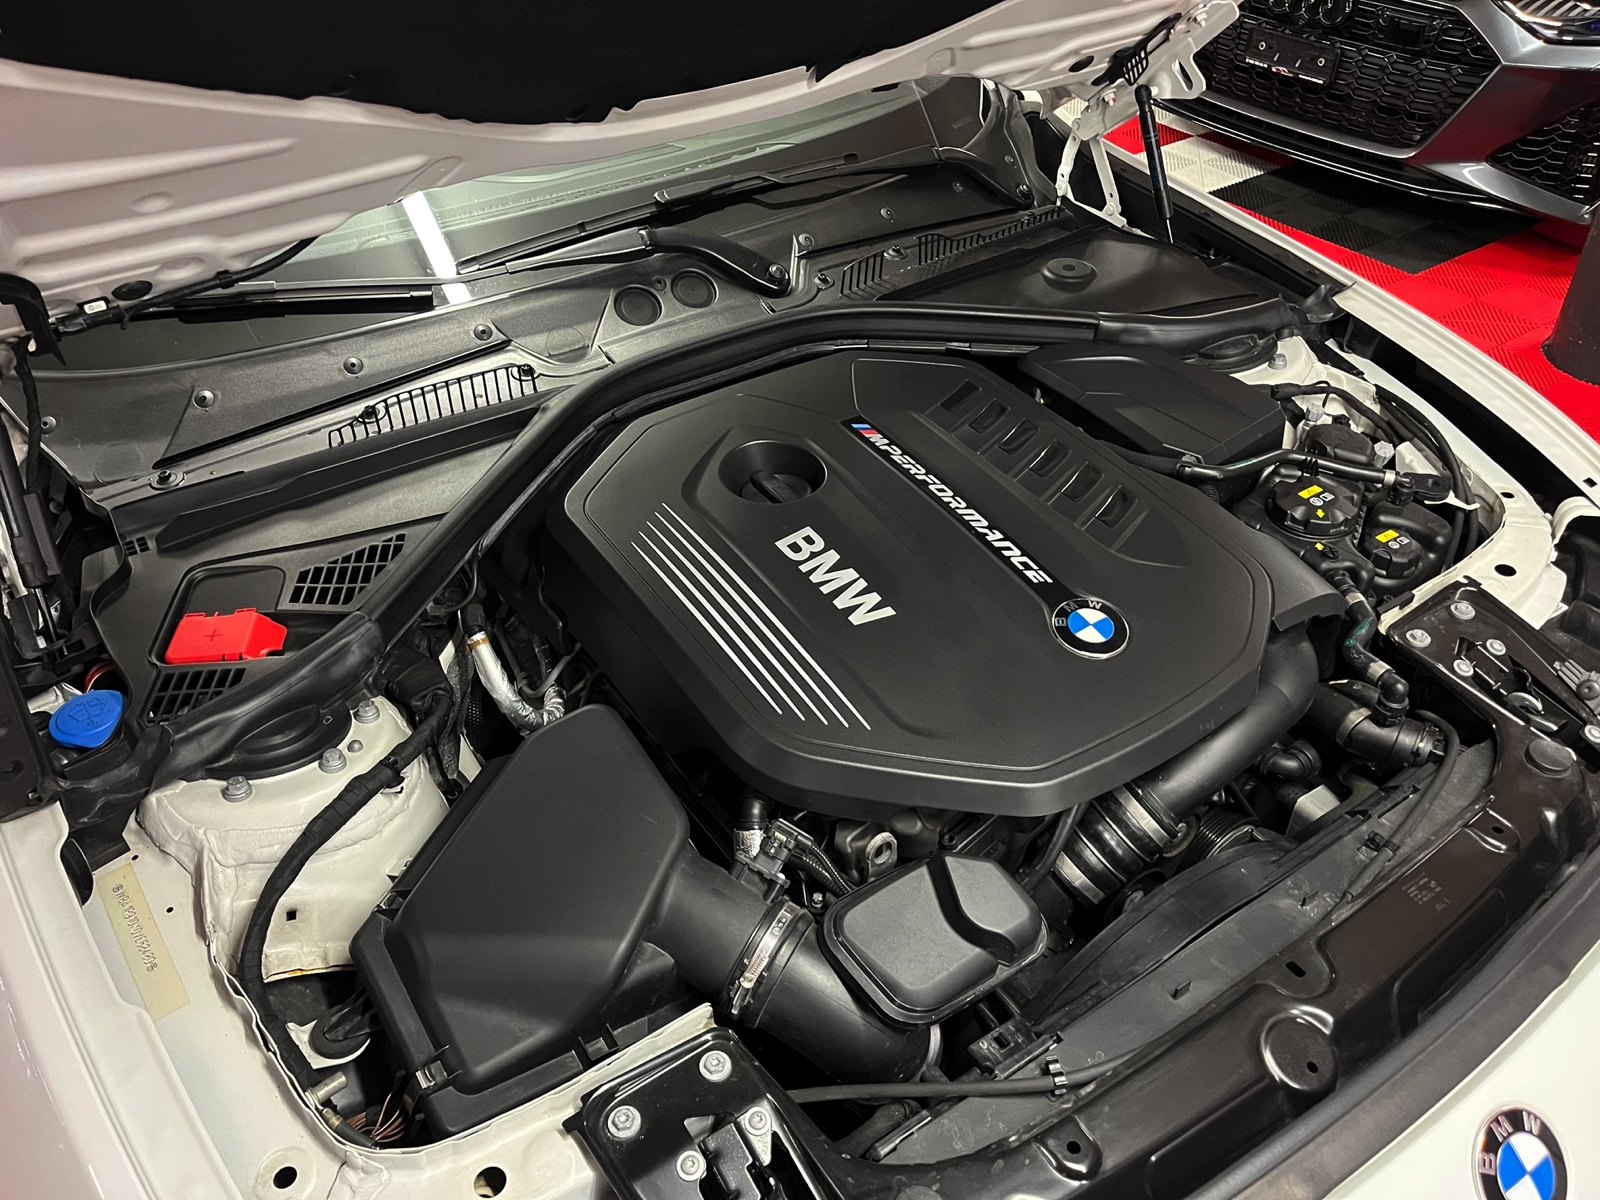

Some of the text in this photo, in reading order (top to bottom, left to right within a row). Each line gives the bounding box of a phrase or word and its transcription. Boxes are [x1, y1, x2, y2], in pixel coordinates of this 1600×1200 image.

[775, 526, 897, 626] BMW
[1054, 600, 1103, 627] BMW
[1479, 1110, 1540, 1175] BMW
